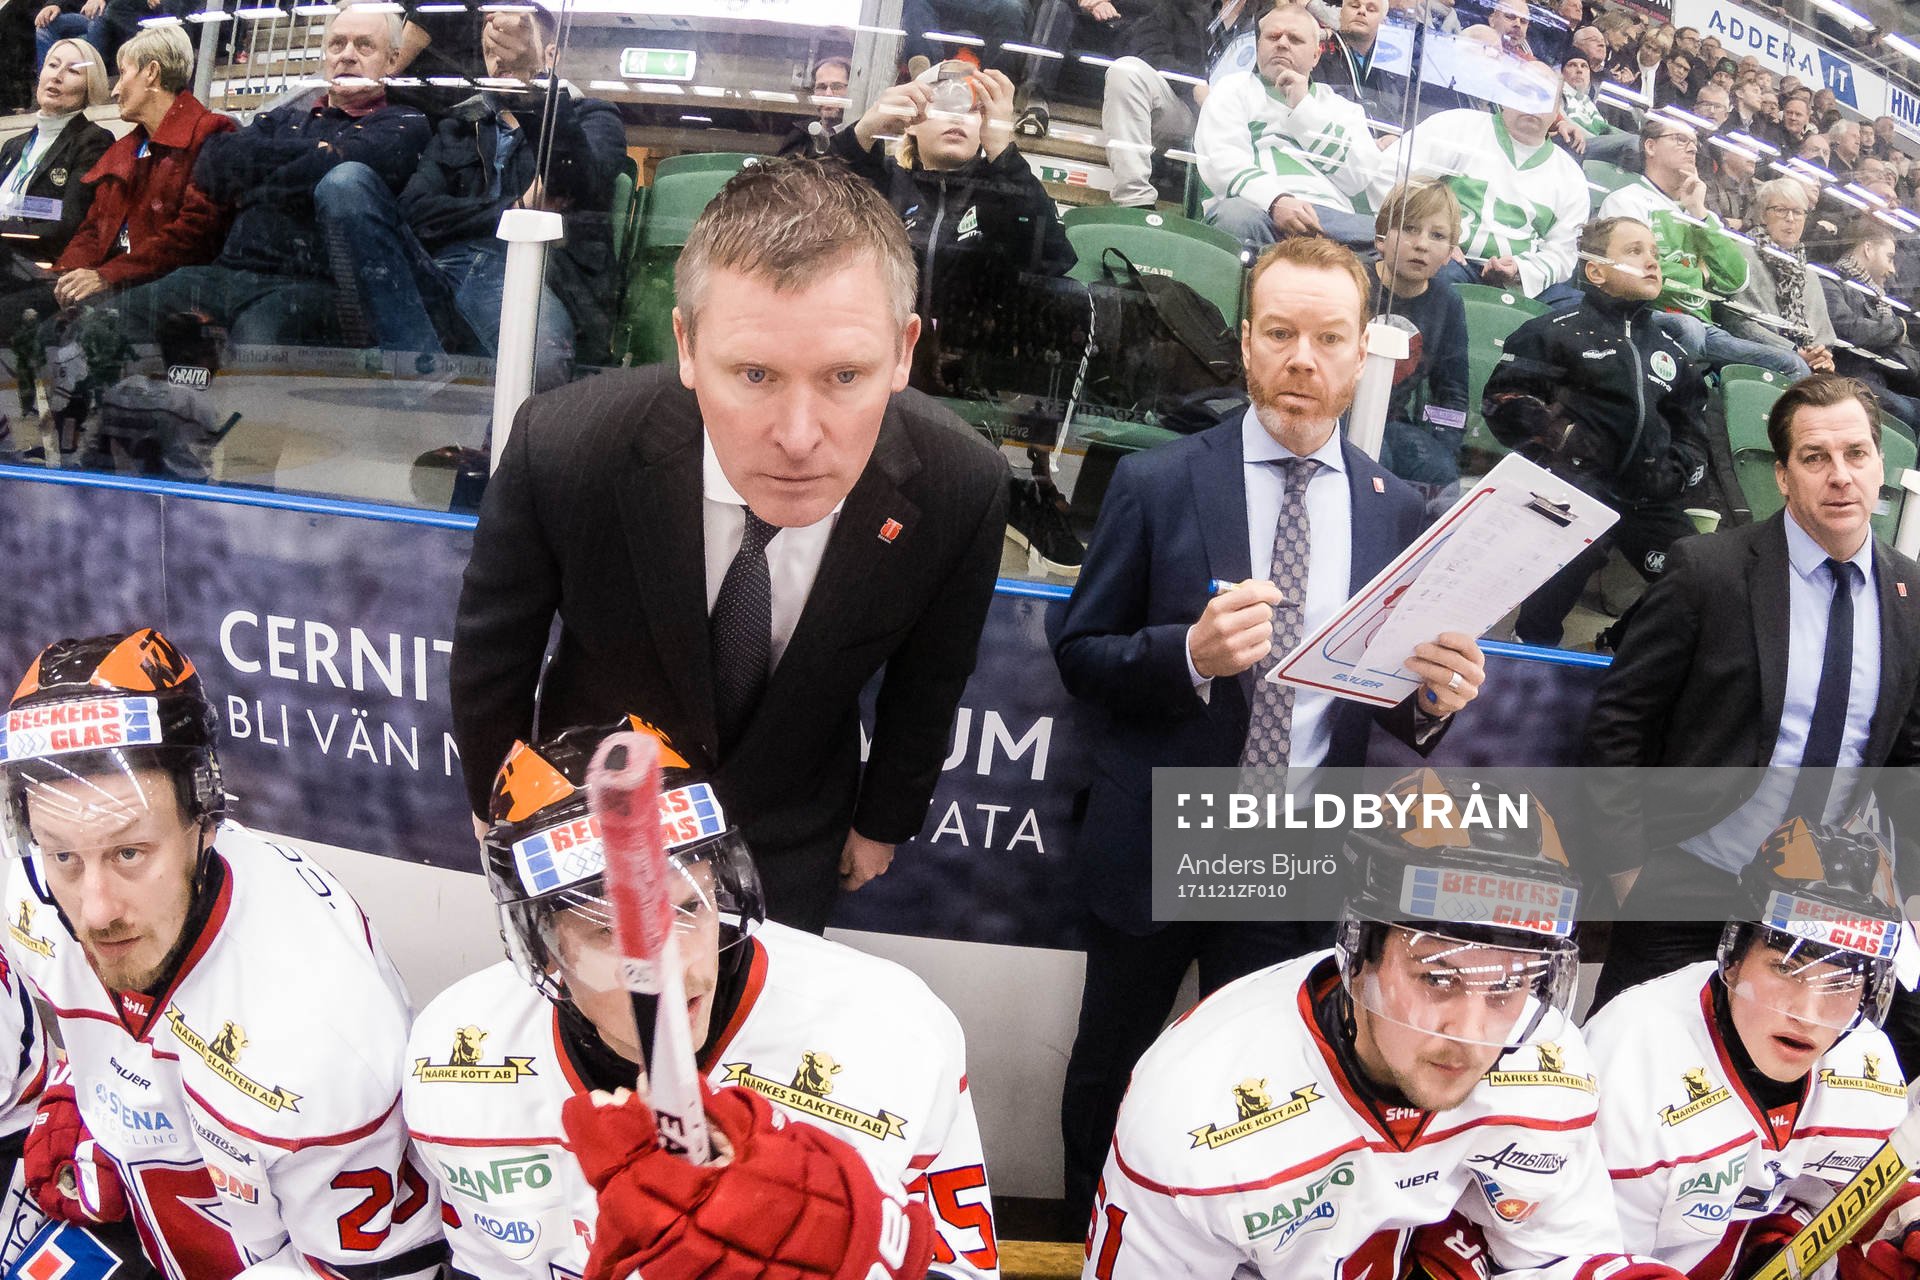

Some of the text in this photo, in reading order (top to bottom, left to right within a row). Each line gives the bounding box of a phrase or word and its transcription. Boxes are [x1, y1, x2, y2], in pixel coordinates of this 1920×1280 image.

[1708, 9, 1814, 77] ADDERA
[1829, 65, 1848, 93] IT
[9, 700, 120, 732] BECKERS
[227, 694, 290, 748] BLI
[306, 707, 419, 771] VÄN
[51, 723, 122, 751] GLAS
[1442, 872, 1560, 907] BECKERS
[1492, 904, 1556, 932] GLAS
[1794, 900, 1885, 936] BECKERS
[1829, 928, 1880, 954] GLAS
[206, 1053, 258, 1095] SLAKTERI
[259, 1091, 277, 1107] AB
[493, 1070, 512, 1079] AB
[789, 1092, 858, 1125] SLAKTERI
[861, 1121, 882, 1134] AB
[1287, 1102, 1303, 1115] AB
[439, 1153, 553, 1203] DANFO
[473, 1213, 536, 1245] MOAB
